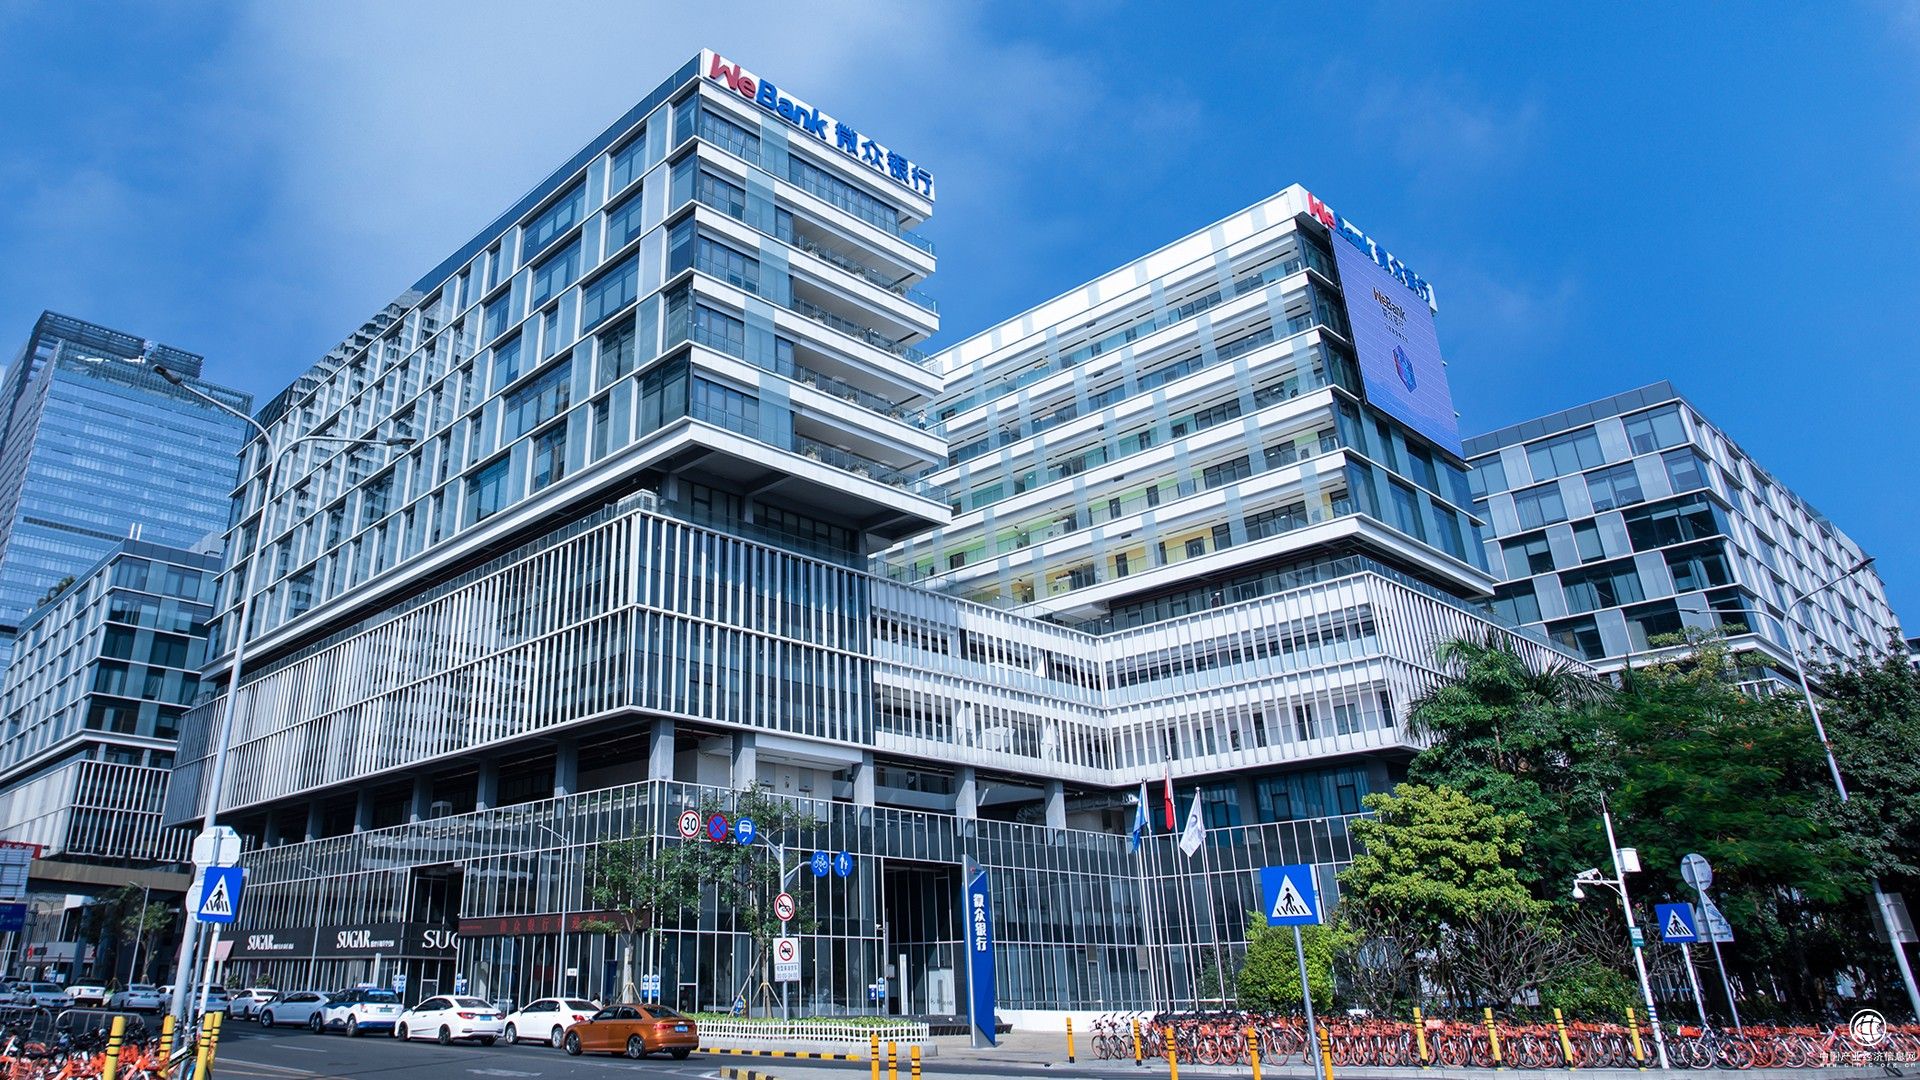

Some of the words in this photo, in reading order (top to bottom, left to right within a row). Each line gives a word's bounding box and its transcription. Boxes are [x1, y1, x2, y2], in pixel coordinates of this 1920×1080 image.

[709, 53, 829, 140] WeBank
[835, 121, 933, 196] 微众银行
[684, 817, 697, 831] 30
[973, 893, 987, 951] 微众银行
[247, 934, 274, 950] SUGAR
[336, 930, 370, 949] SUGAR
